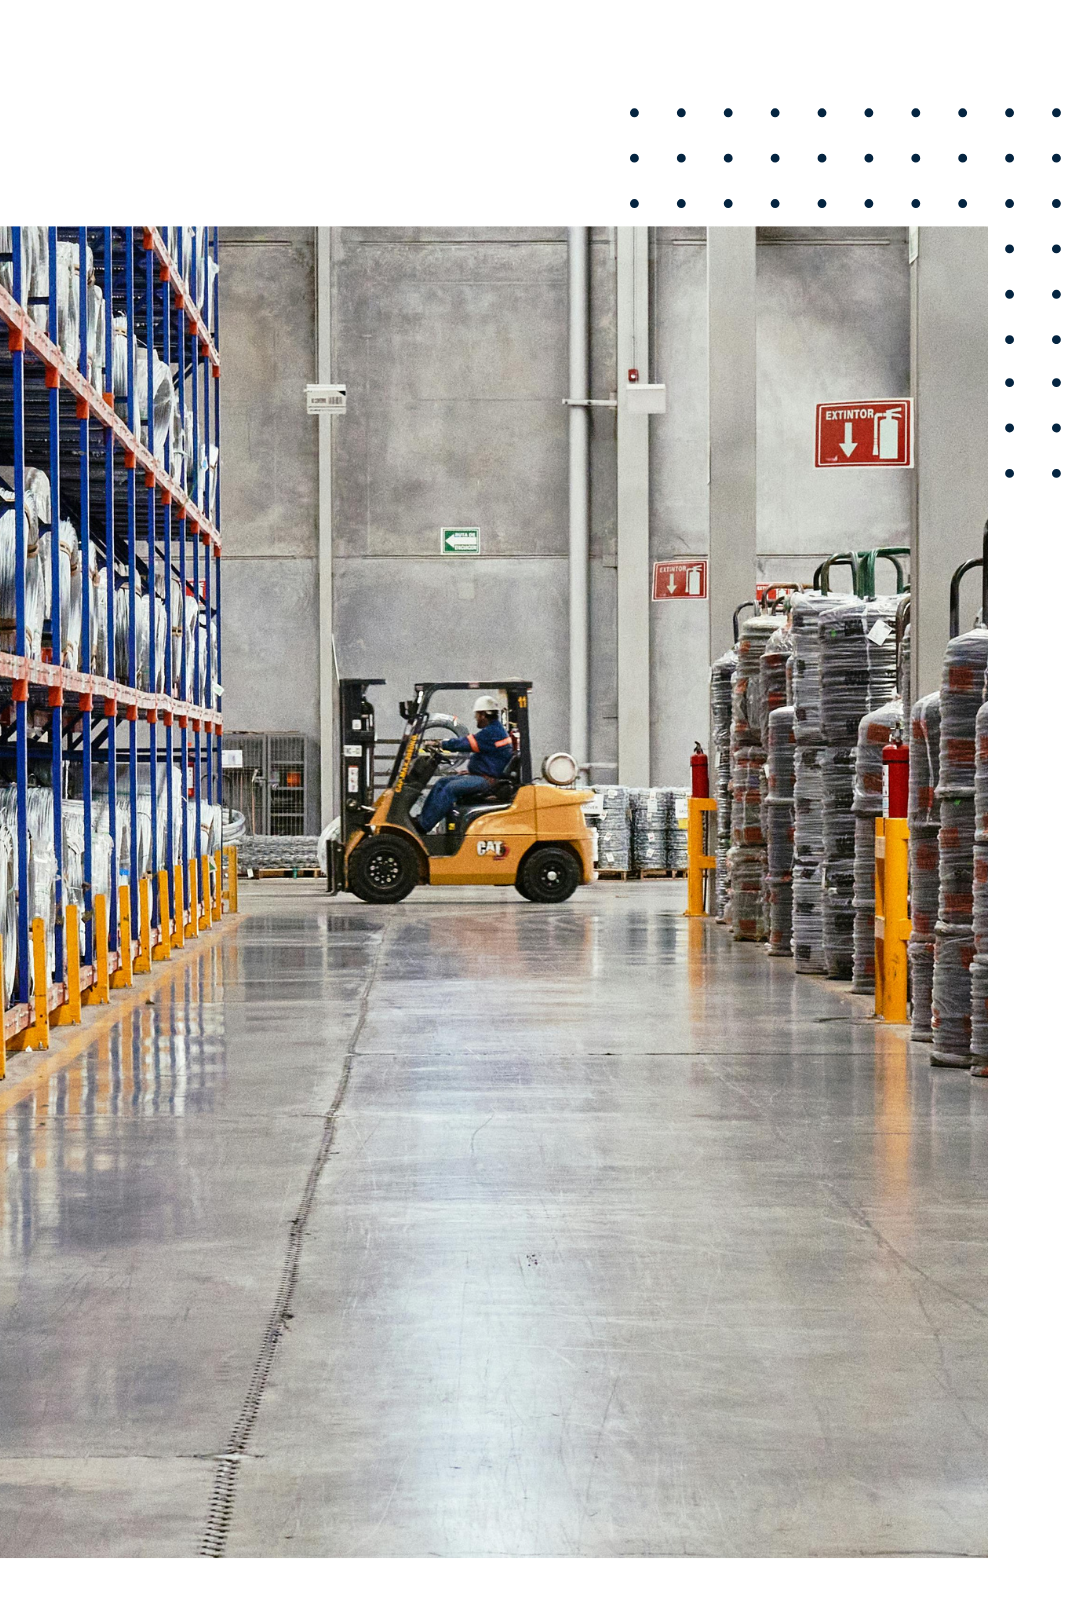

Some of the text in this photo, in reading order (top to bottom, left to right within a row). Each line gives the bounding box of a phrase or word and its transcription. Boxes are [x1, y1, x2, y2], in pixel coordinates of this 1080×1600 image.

[825, 408, 874, 420] EXTINTOR
[659, 565, 687, 573] EXTINTOR
[518, 695, 527, 708] 11
[477, 840, 503, 856] CAT
